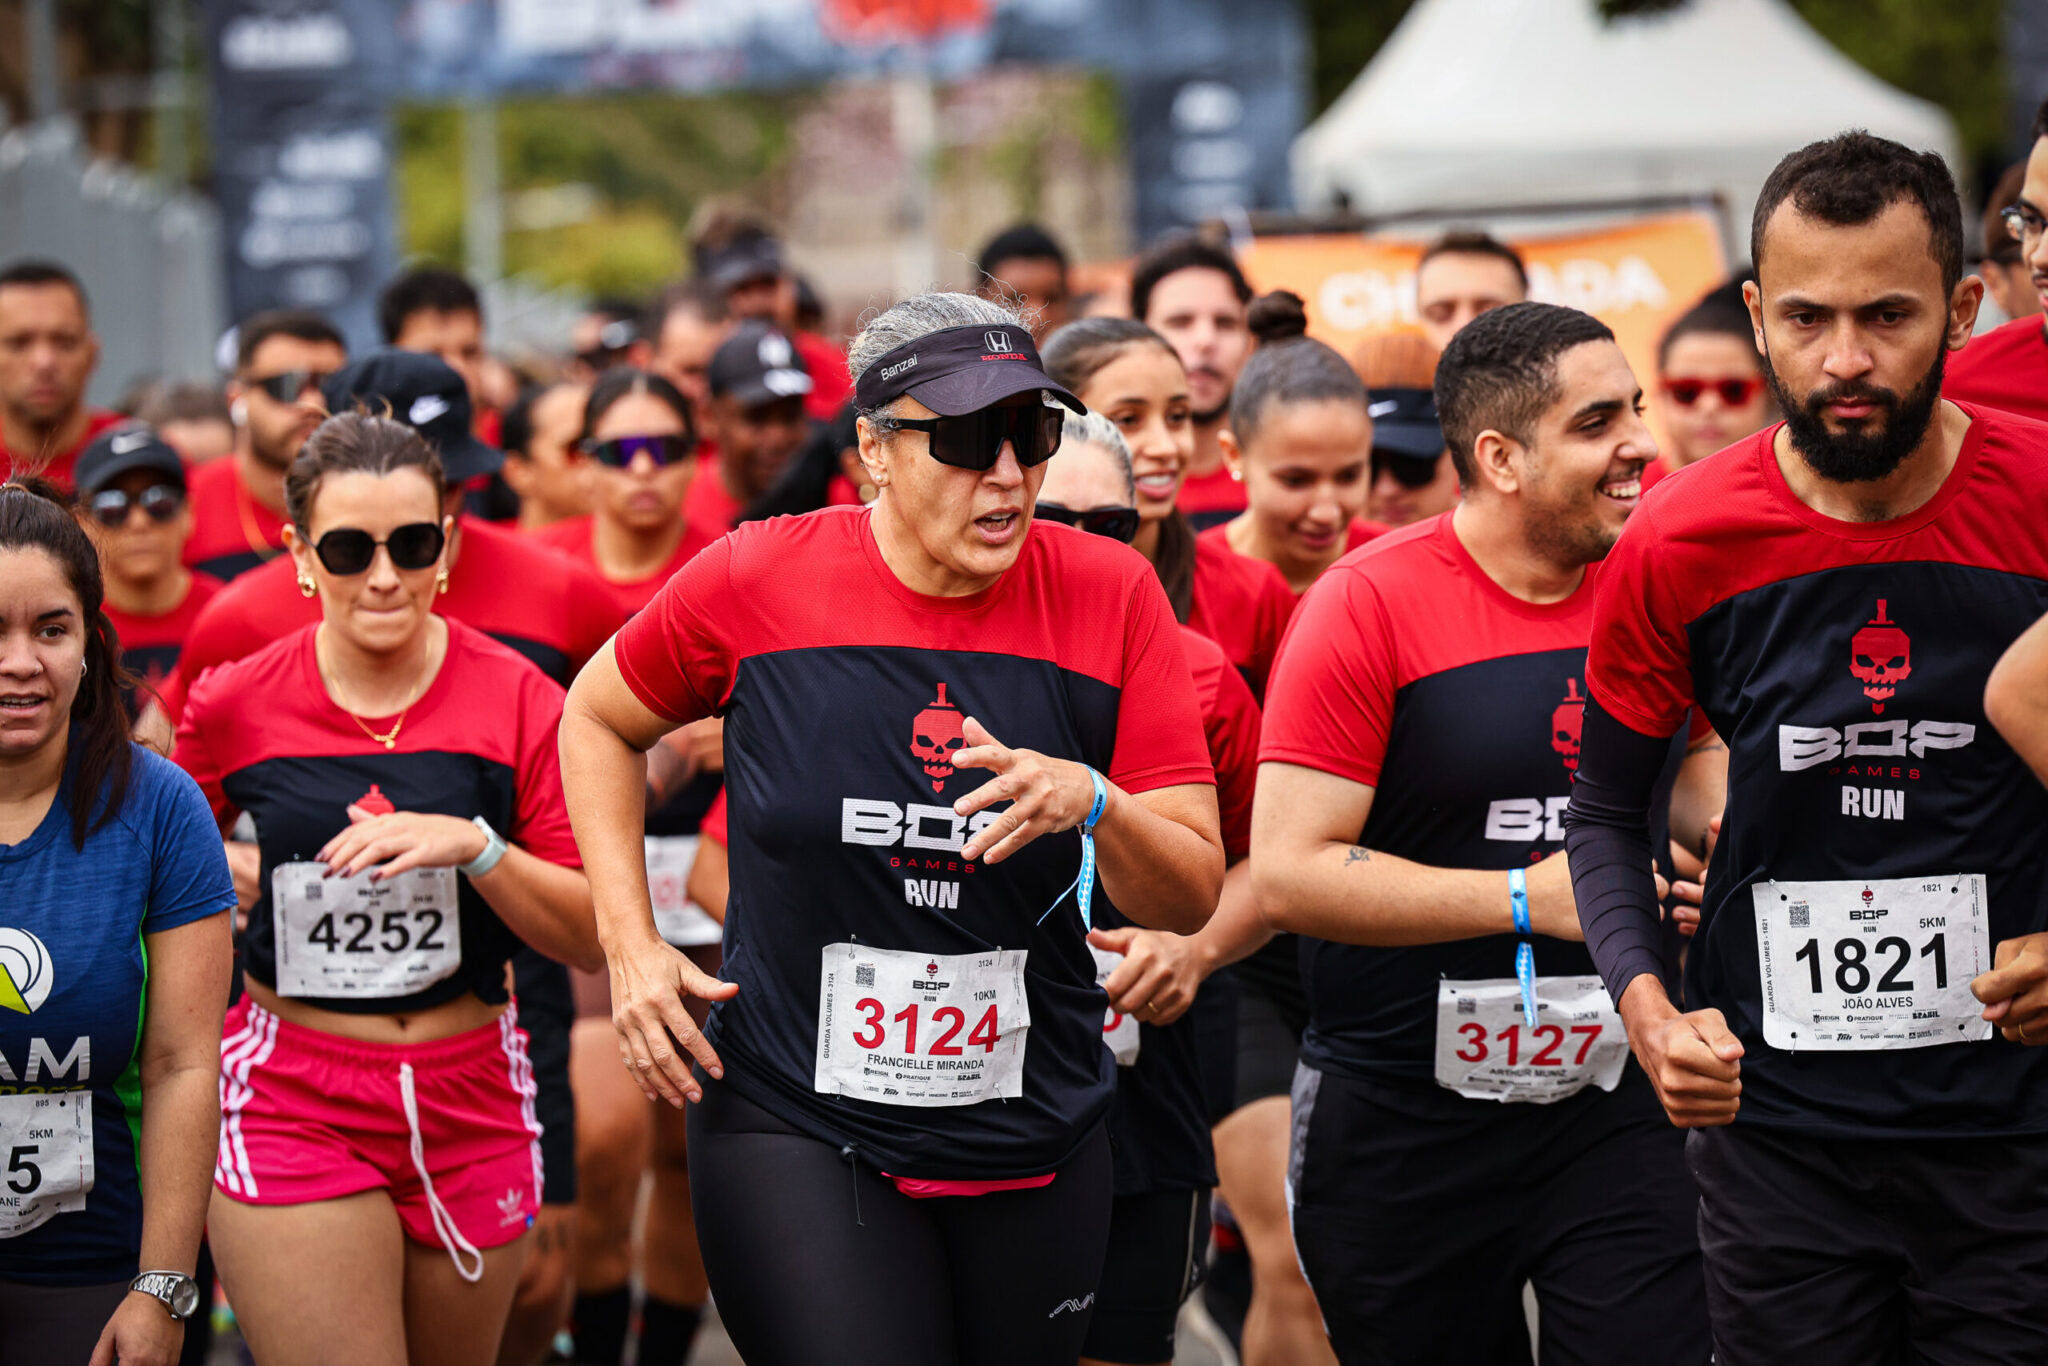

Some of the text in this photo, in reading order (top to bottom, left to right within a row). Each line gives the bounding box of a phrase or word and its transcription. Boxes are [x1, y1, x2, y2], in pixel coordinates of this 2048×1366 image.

[980, 353, 1028, 361] HONDA
[880, 354, 918, 382] Banzai
[1778, 719, 1976, 772] BOP
[1828, 765, 1921, 780] GAMES
[1841, 785, 1905, 821] RUN
[890, 857, 976, 874] GAMES
[904, 878, 960, 910] RUN
[1921, 884, 1942, 893] 1821
[1849, 909, 1888, 920] BOP
[1919, 916, 1946, 929] 5KM
[308, 909, 445, 954] 4252
[978, 959, 993, 967] 3124
[1764, 940, 1772, 978] VOLUMES
[1796, 932, 1948, 994] 1821
[912, 980, 950, 991] BOP
[974, 990, 996, 1001] 10KM
[1767, 980, 1776, 1013] GUARDA
[1842, 996, 1913, 1010] JOÃO ALVES
[826, 993, 834, 1027] VOLUMES
[1514, 1003, 1548, 1012] BP
[852, 998, 1002, 1056] 3124
[824, 1028, 832, 1059] GUARDA
[1456, 1022, 1603, 1066] 3127
[868, 1054, 985, 1070] FRANCIELLE MIRANDA
[36, 1100, 50, 1108] 895
[29, 1128, 54, 1140] 5KM
